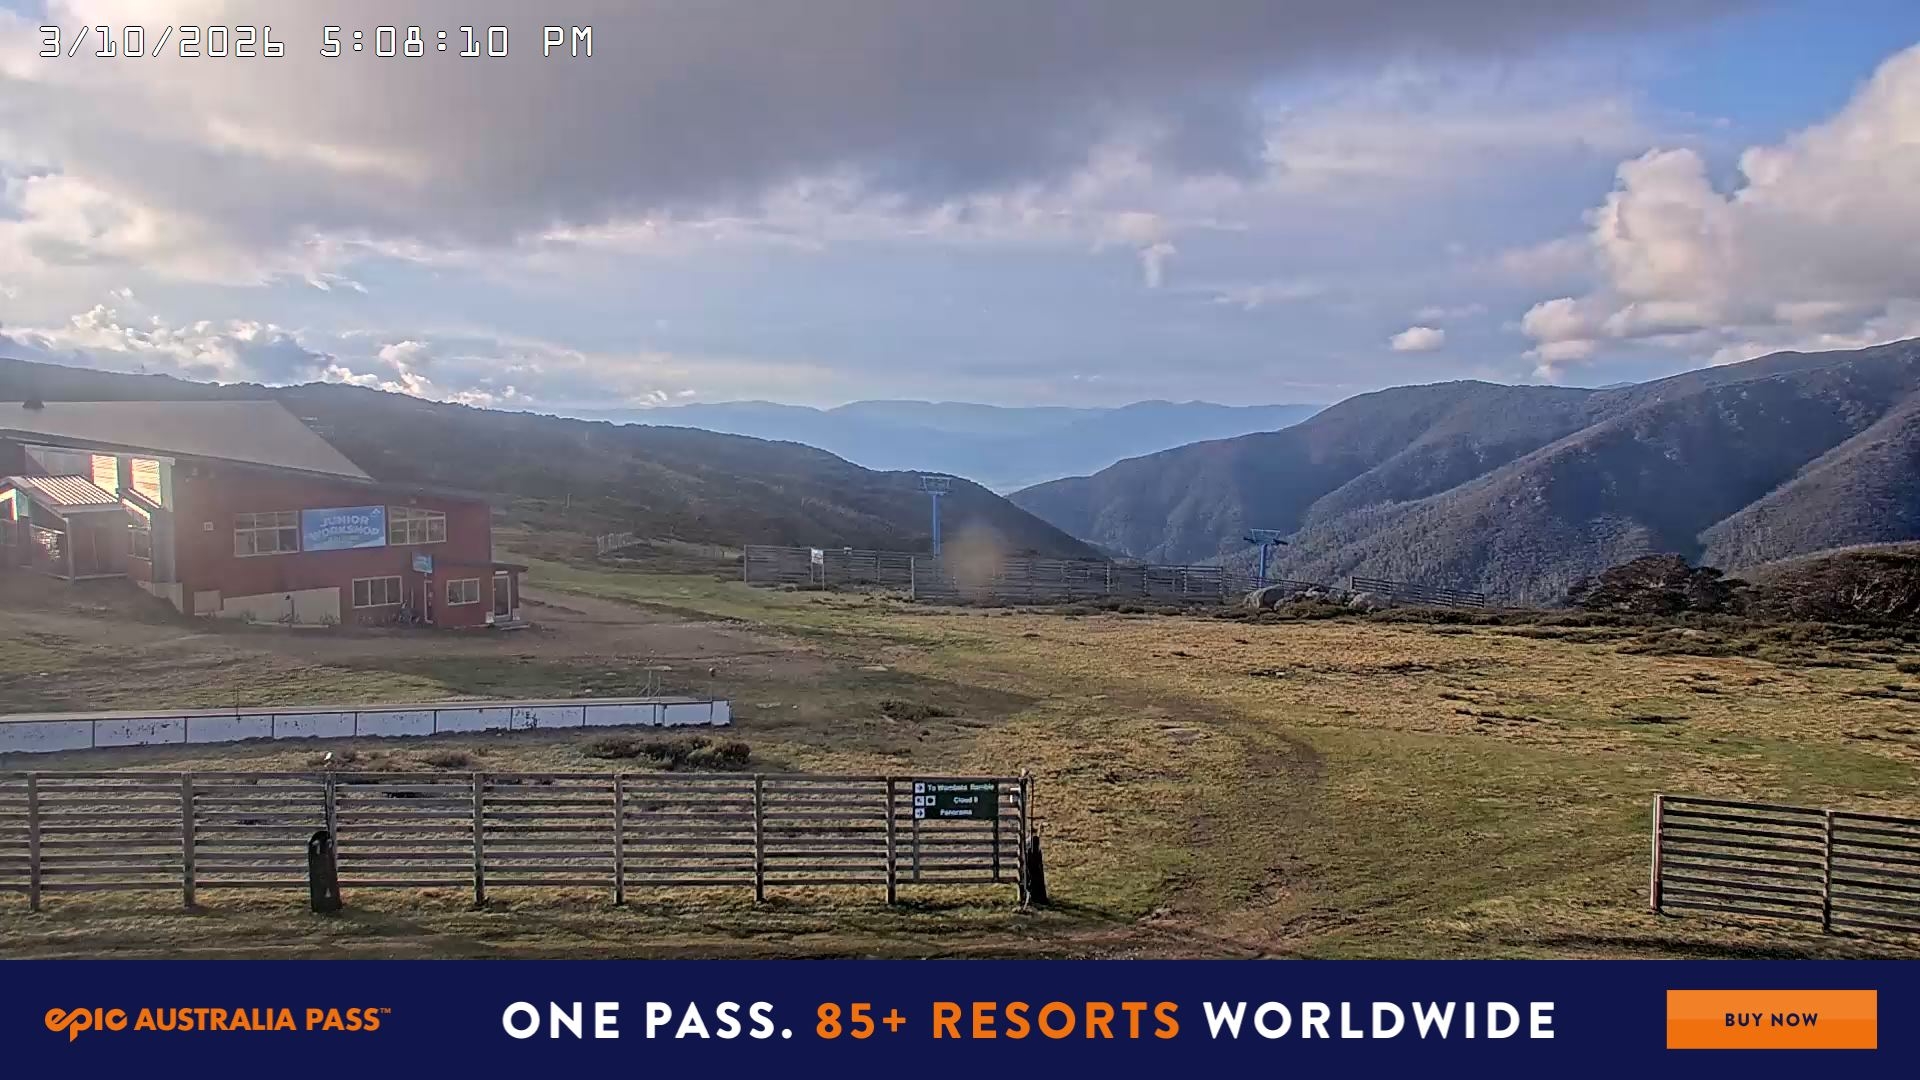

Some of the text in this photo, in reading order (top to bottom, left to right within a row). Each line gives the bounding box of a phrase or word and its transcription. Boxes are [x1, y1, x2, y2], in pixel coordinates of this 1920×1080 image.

[320, 515, 370, 527] JUNIOR
[311, 525, 380, 541] WORKSHOP
[940, 808, 973, 816] Panorama
